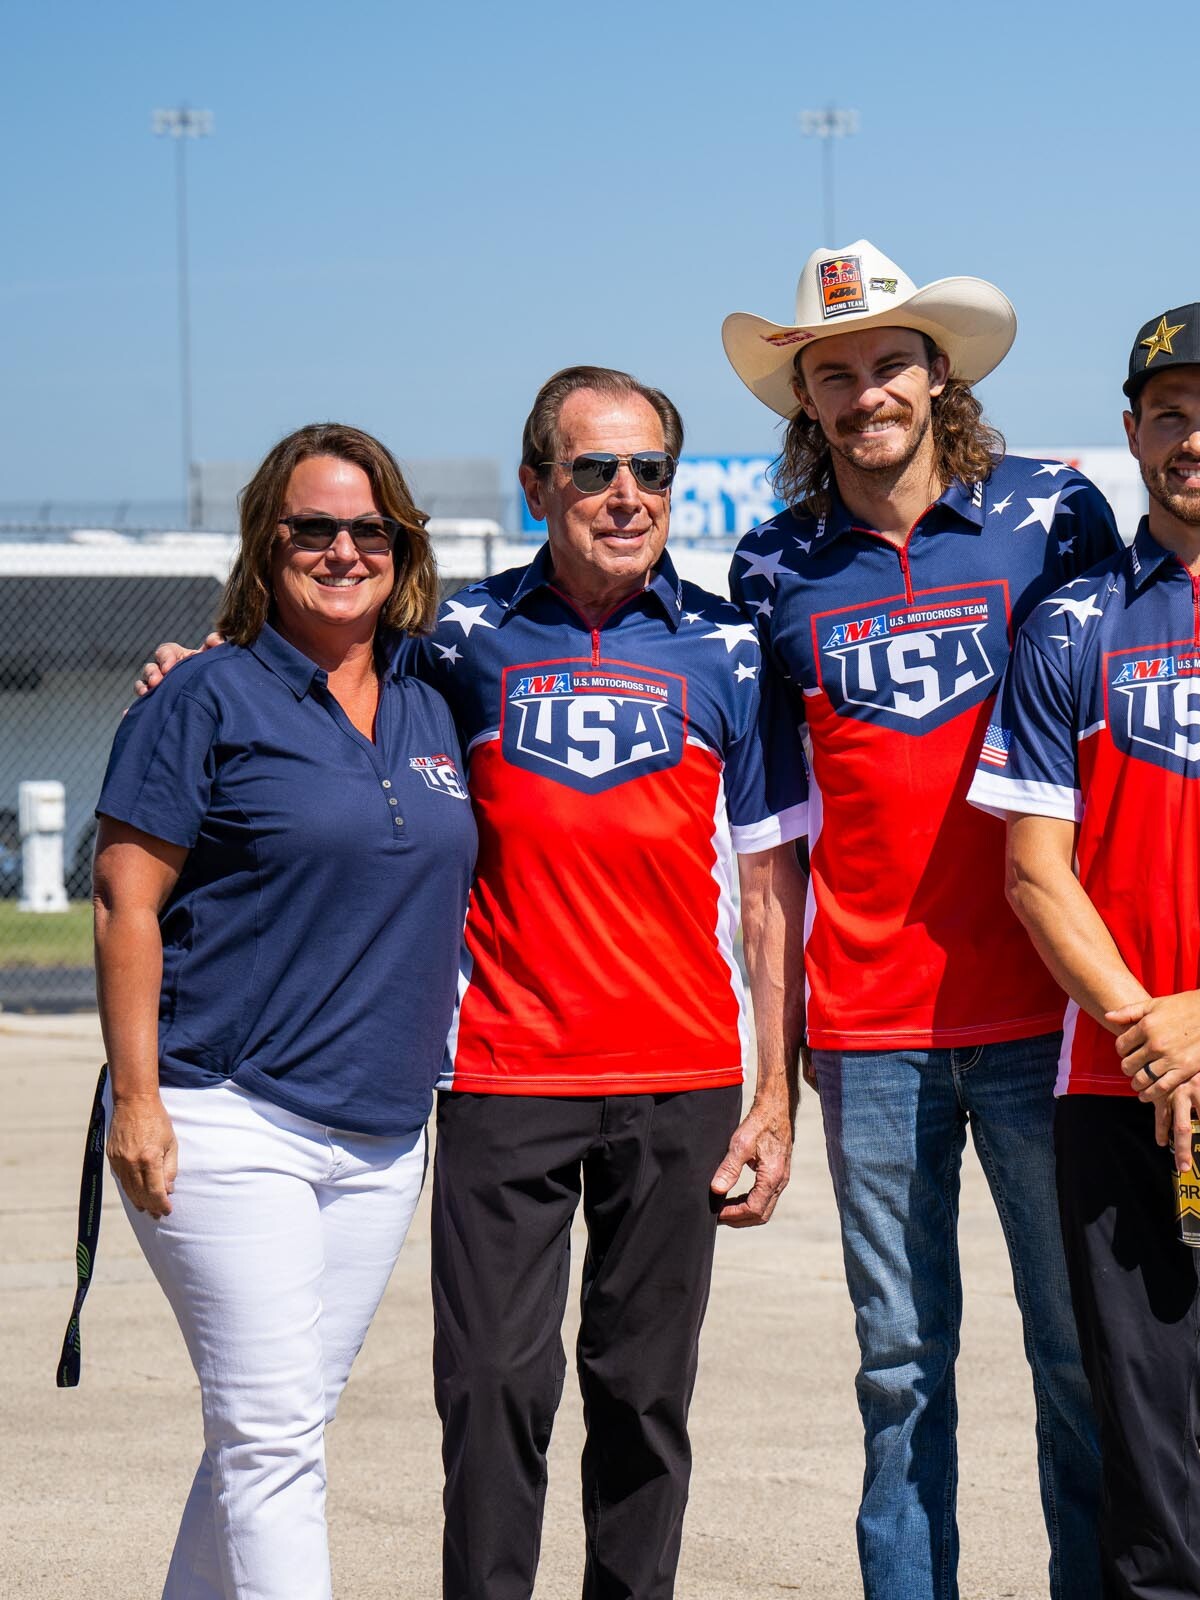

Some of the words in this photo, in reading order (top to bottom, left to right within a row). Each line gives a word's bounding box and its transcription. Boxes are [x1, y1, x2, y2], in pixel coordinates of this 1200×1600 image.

[822, 273, 840, 288] Red
[841, 270, 860, 282] Bull
[829, 286, 857, 299] KTM
[826, 302, 847, 313] RACING
[848, 300, 864, 309] TEAM
[823, 615, 889, 649] AMA
[889, 616, 906, 627] U.S.
[907, 607, 962, 623] MOTOCROSS
[962, 604, 988, 616] TEAM
[824, 623, 994, 720] USA
[1112, 656, 1177, 685] AMA
[1177, 660, 1192, 669] U.S.
[509, 673, 572, 698] AMA
[573, 677, 589, 687] U.S.
[591, 677, 644, 691] MOTOCROSS
[645, 685, 668, 697] TEAM
[509, 695, 670, 778] USA
